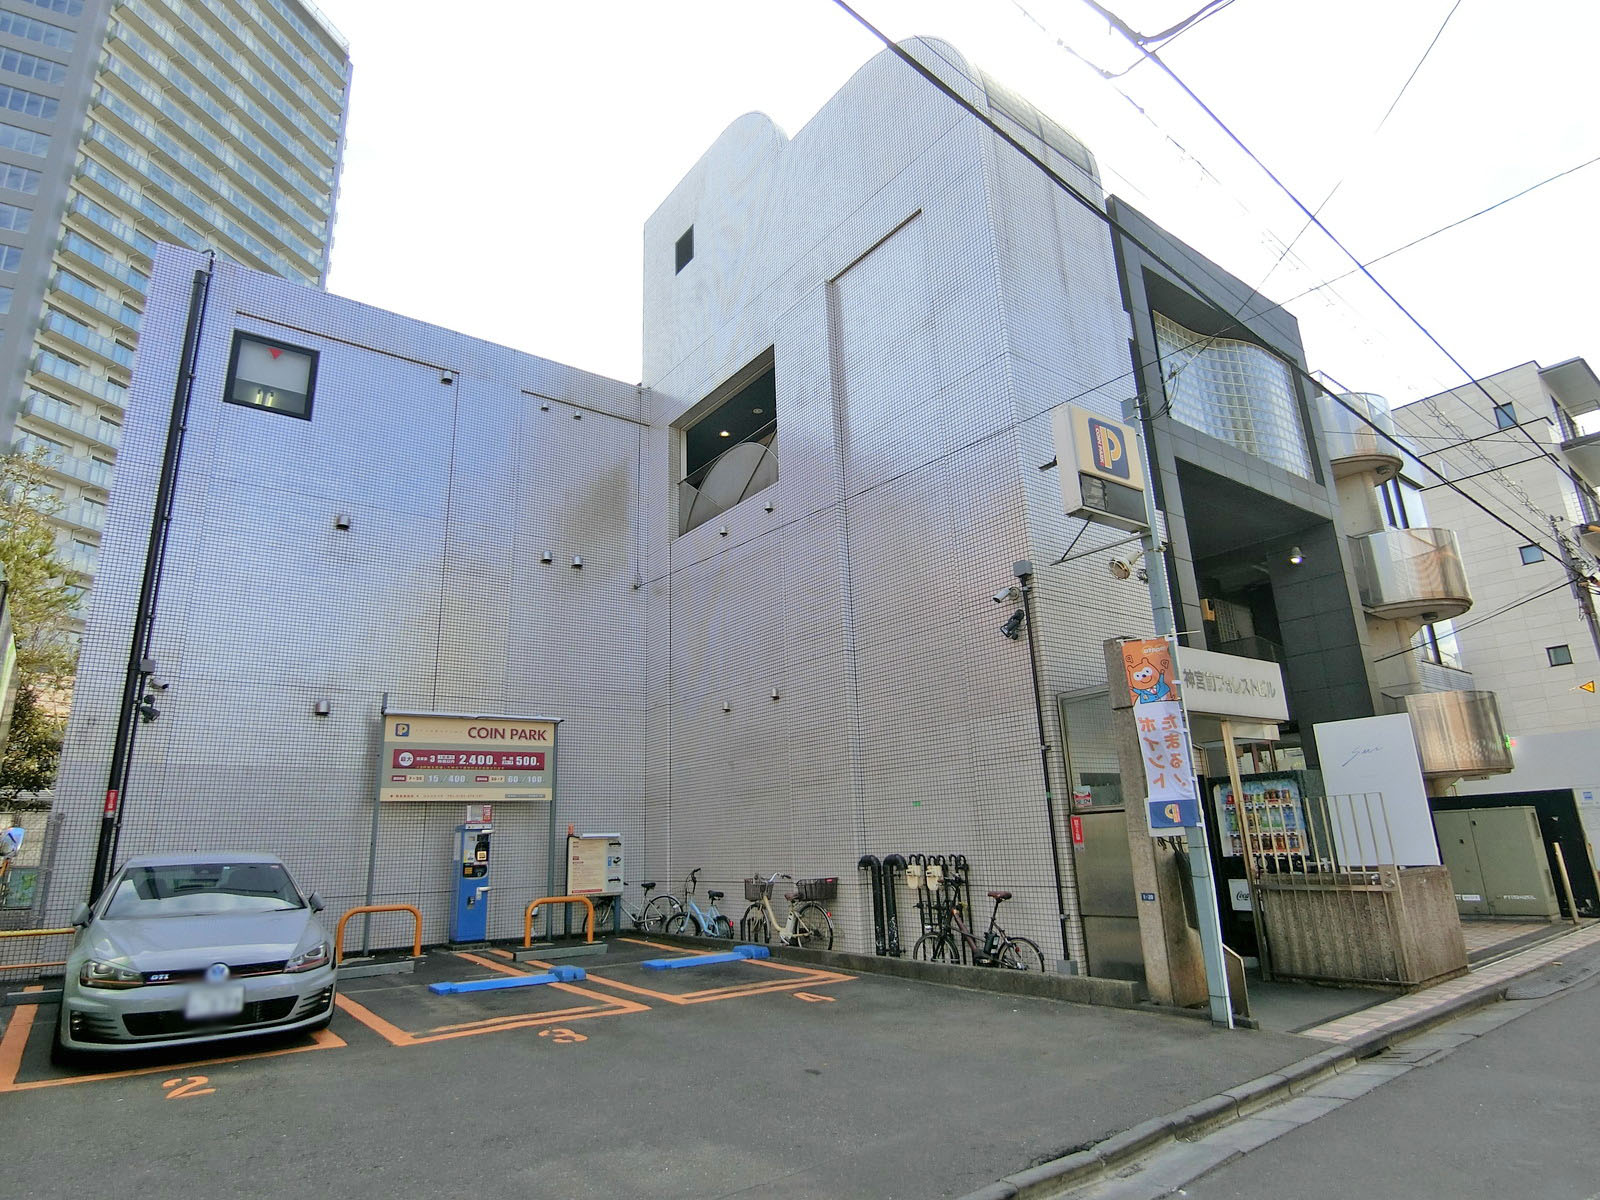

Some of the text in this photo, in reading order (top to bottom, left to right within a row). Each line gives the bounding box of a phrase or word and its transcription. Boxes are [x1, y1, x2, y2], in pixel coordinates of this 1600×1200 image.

[1099, 426, 1122, 469] P
[1183, 668, 1276, 698] 神宮前フォレストビル
[468, 727, 505, 739] COIN
[510, 728, 547, 741] PARK
[538, 1028, 588, 1043] 3
[162, 1075, 216, 1099] 2
